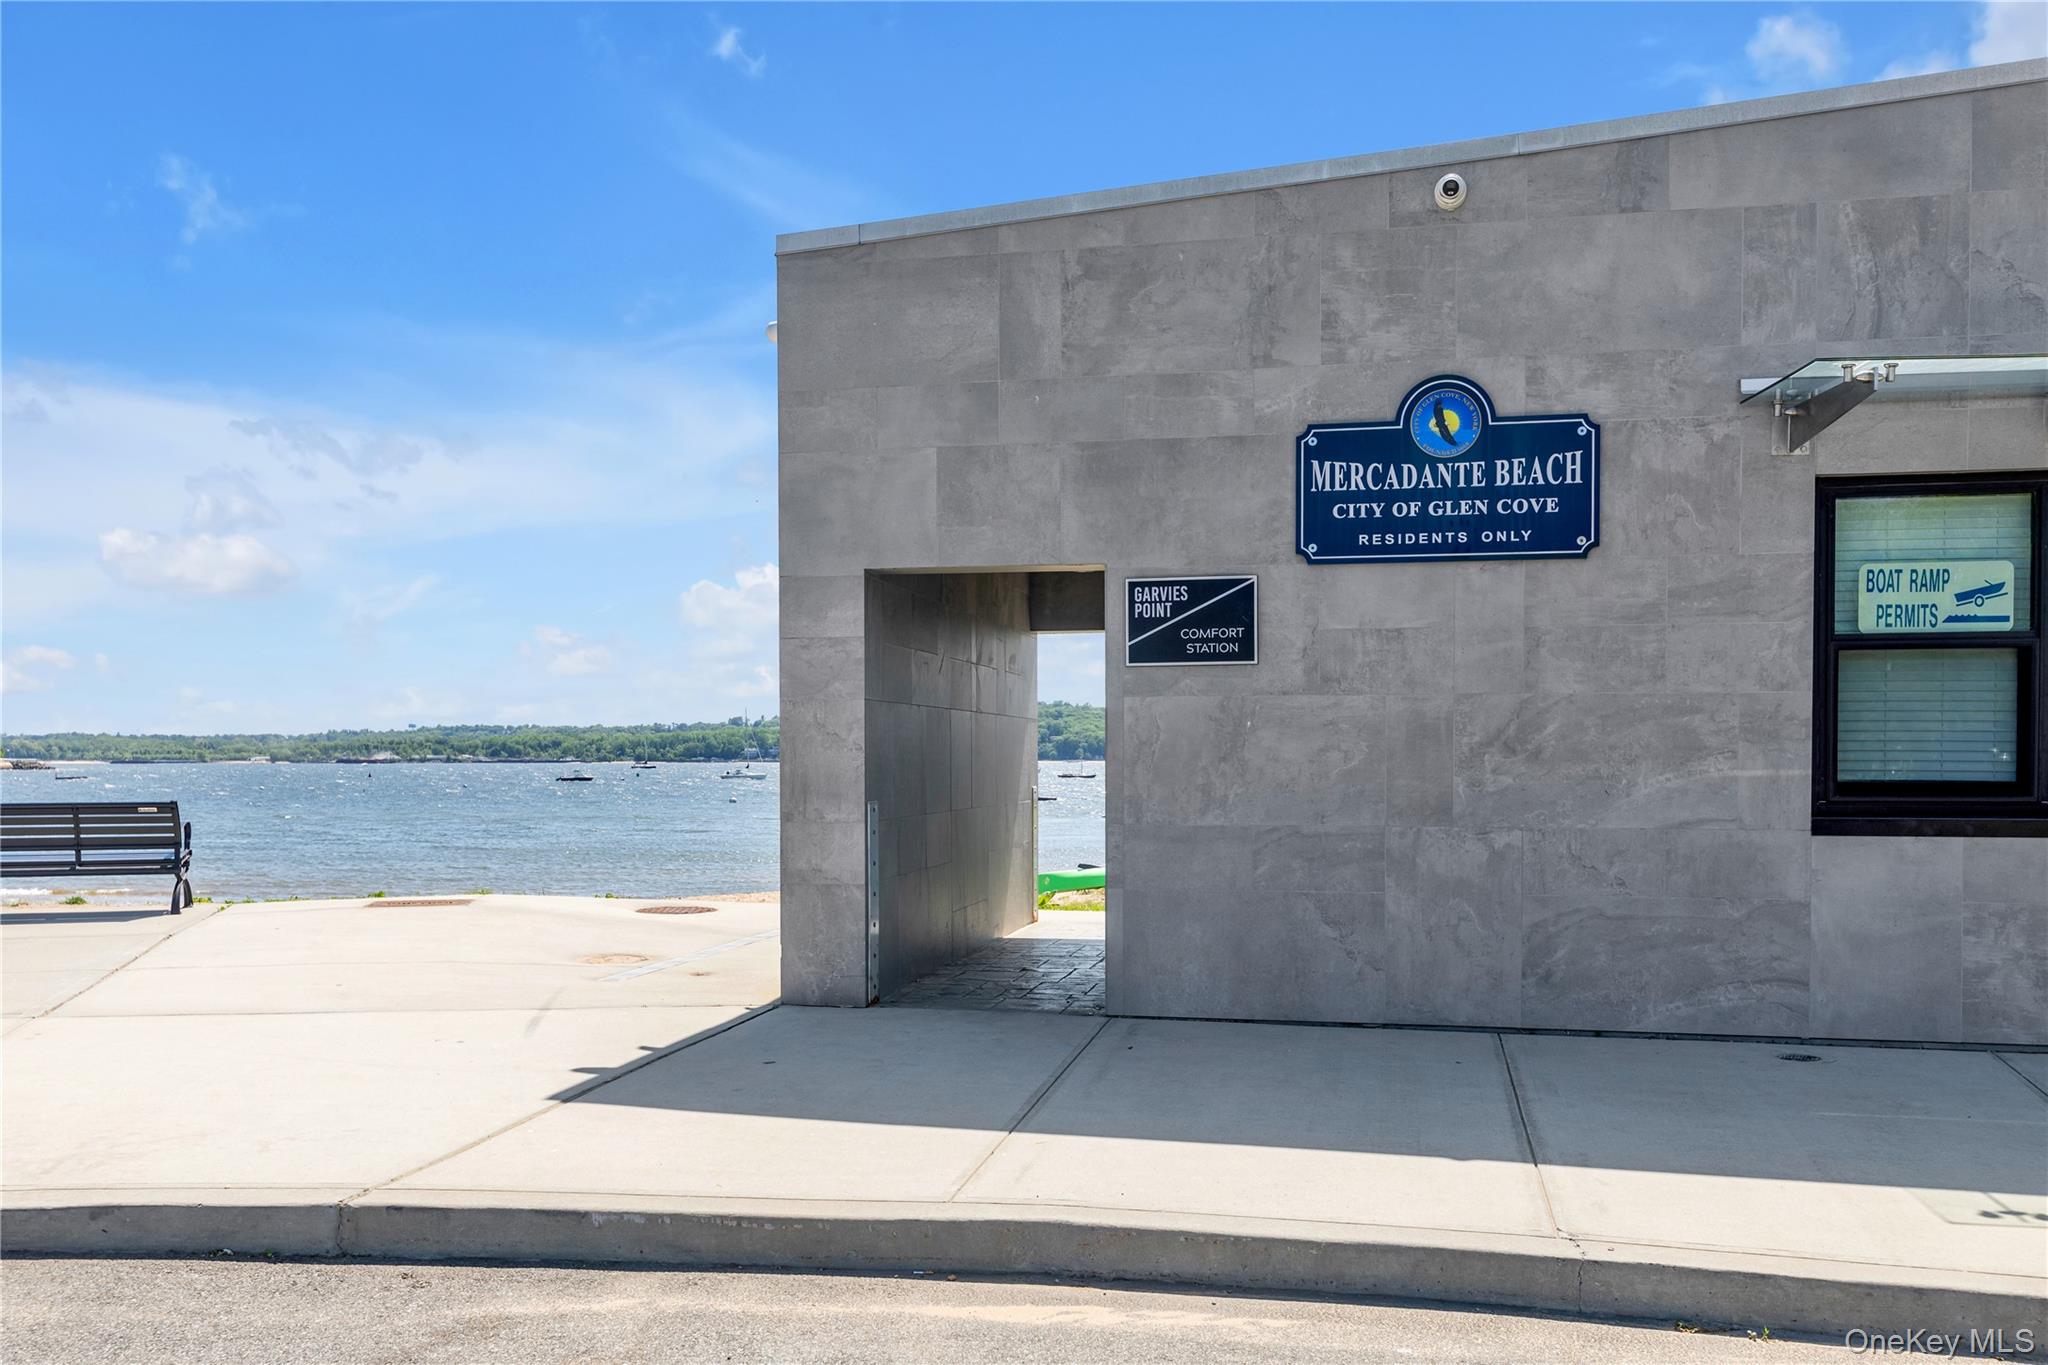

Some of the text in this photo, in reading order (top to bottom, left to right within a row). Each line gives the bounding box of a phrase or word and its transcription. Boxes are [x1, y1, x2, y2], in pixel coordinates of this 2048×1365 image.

[1310, 450, 1583, 492] MERCADANTE BEACH
[1332, 497, 1559, 519] CITY OF GLEN COVE
[1358, 529, 1533, 546] RESIDENTS ONLY
[1866, 568, 1951, 593] BOAT RAMP
[1134, 585, 1188, 602] GARVIES
[1134, 602, 1173, 619] POINT
[1876, 603, 1939, 629] PERMITS
[1180, 627, 1245, 639] COMFORT
[1186, 642, 1239, 654] STATION
